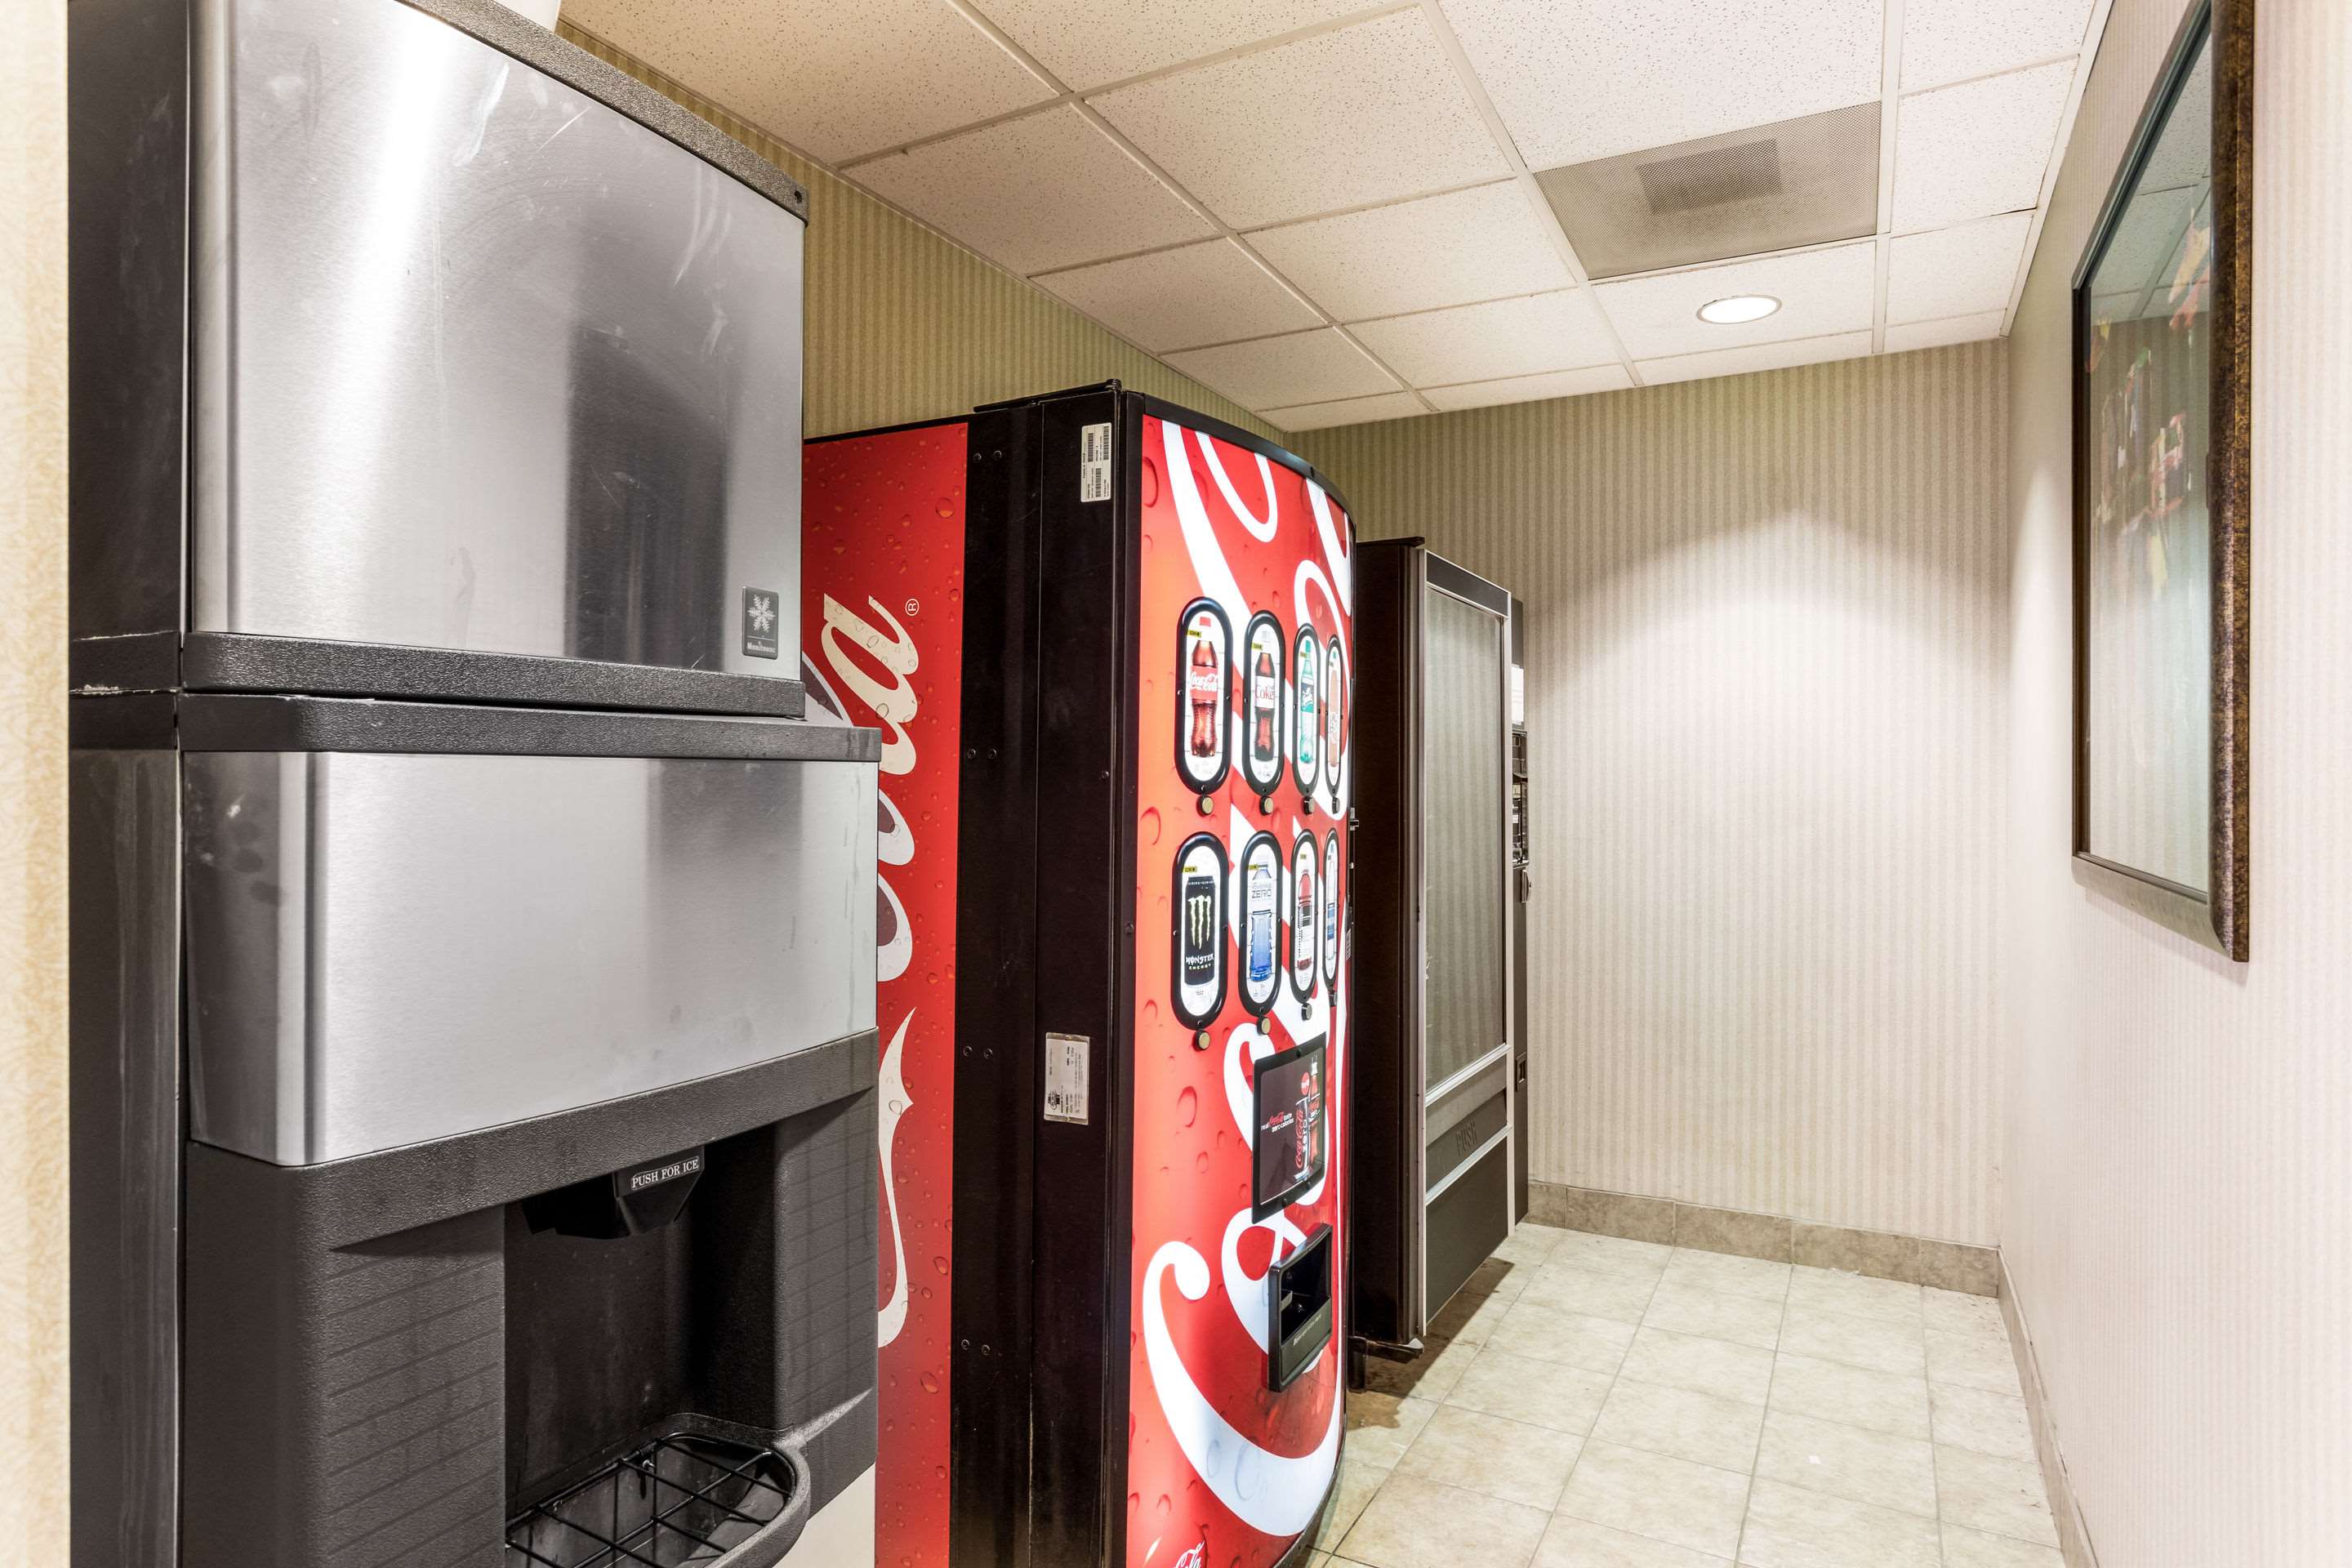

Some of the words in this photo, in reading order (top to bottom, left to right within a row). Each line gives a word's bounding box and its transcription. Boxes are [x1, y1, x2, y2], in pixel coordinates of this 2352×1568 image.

[1255, 685, 1275, 700] Coke
[1252, 889, 1272, 898] ZERO
[1186, 953, 1214, 965] MONSTER
[631, 1172, 658, 1188] PUSH
[662, 1165, 680, 1179] FOR
[683, 1159, 699, 1173] ICE
